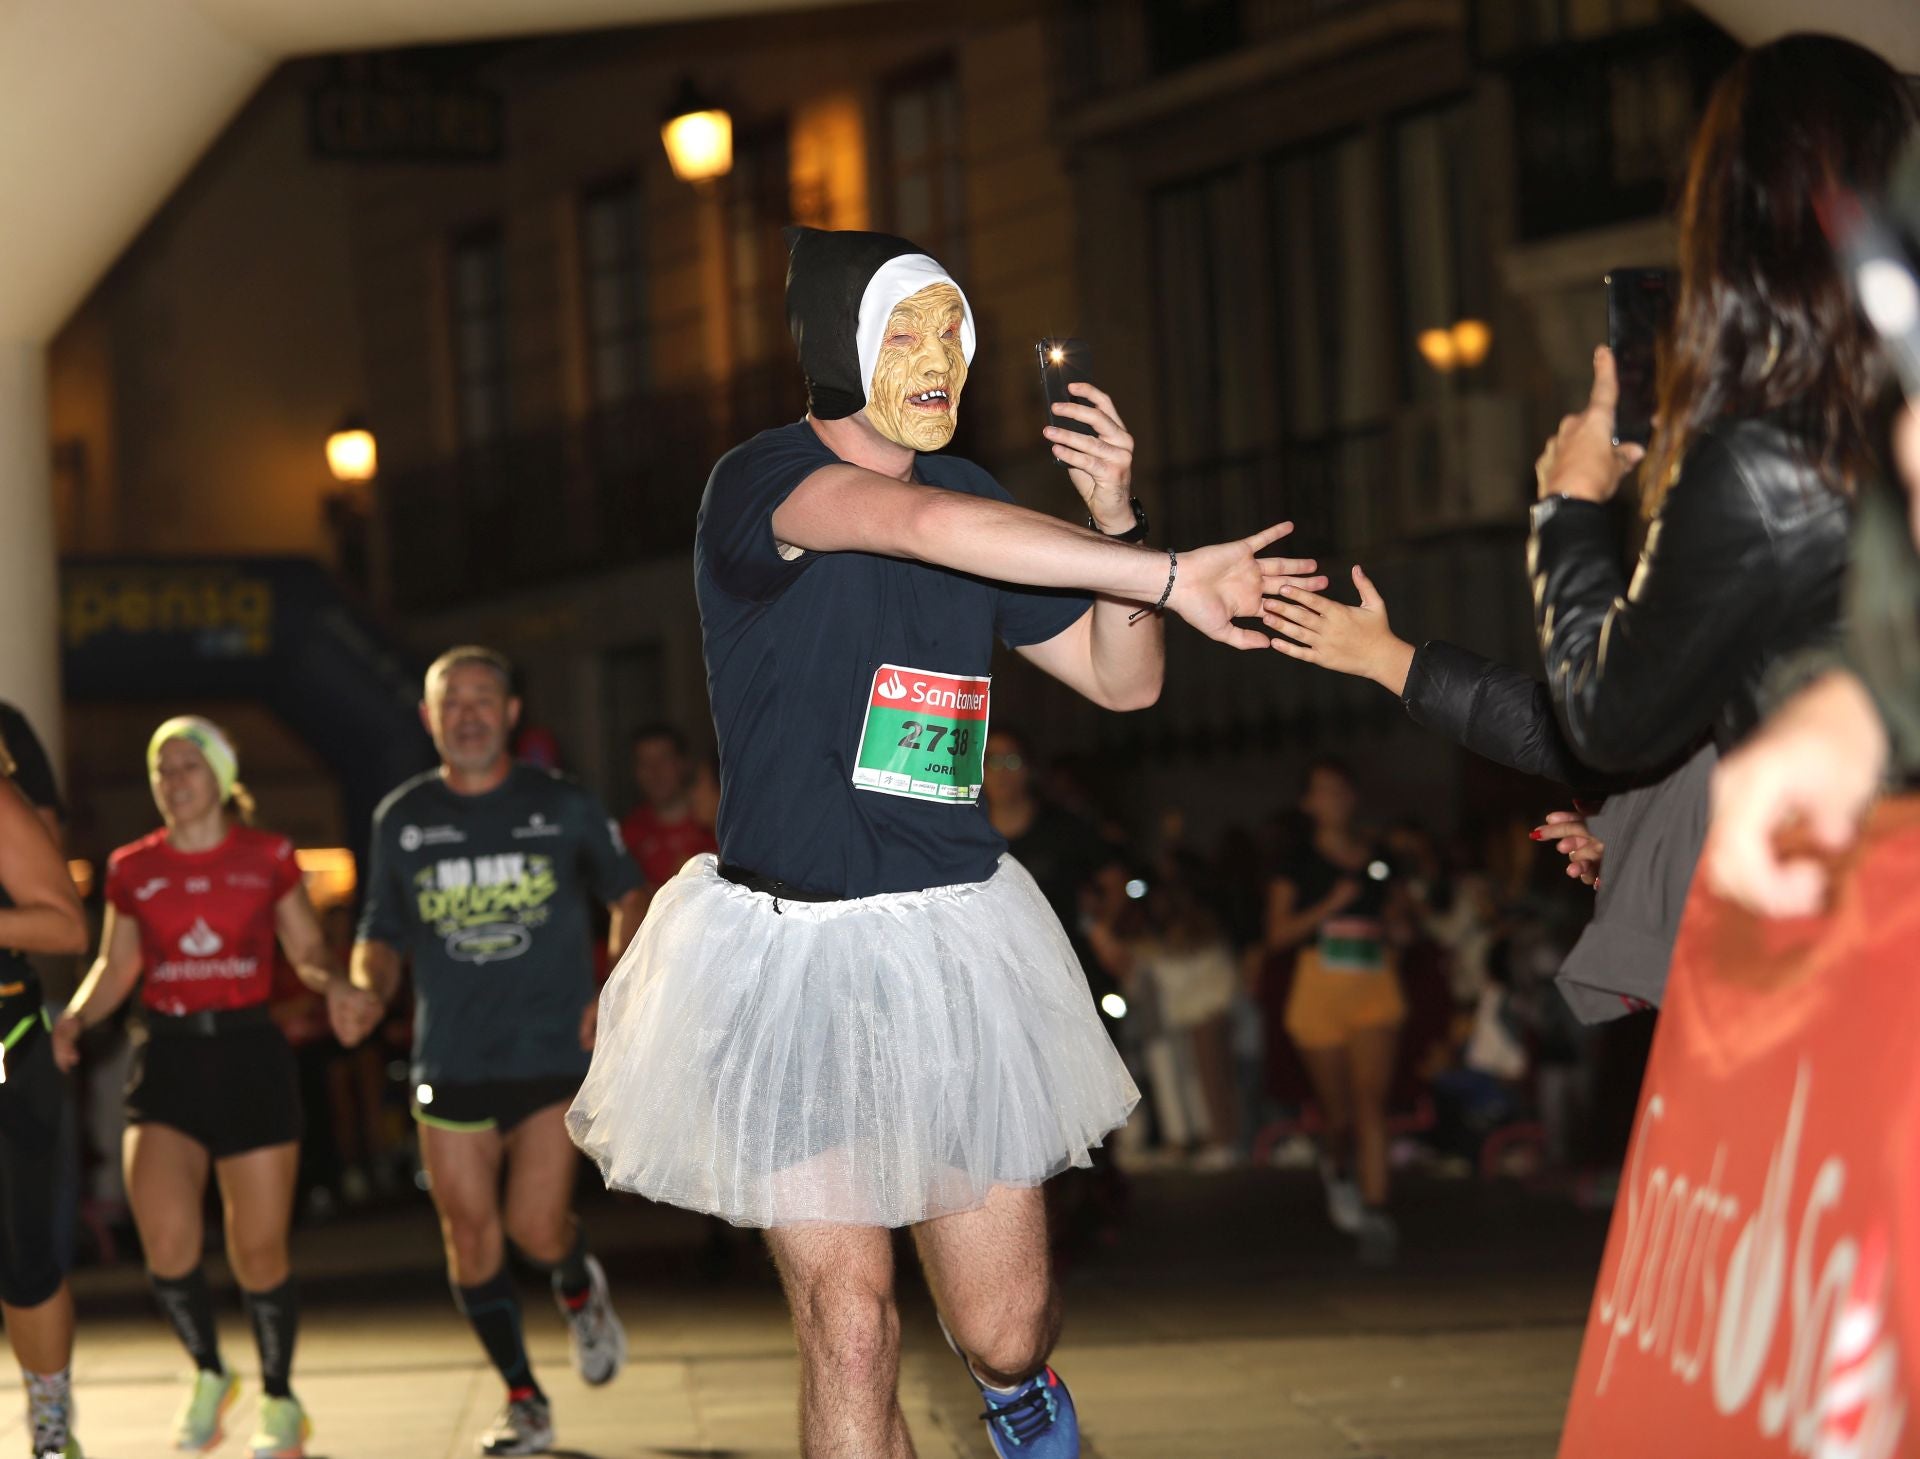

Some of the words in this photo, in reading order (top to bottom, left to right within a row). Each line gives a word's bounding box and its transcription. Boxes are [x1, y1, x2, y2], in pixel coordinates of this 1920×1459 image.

[61, 583, 272, 648] pensa
[898, 720, 969, 757] 2738
[1595, 1095, 1738, 1397] Sports
